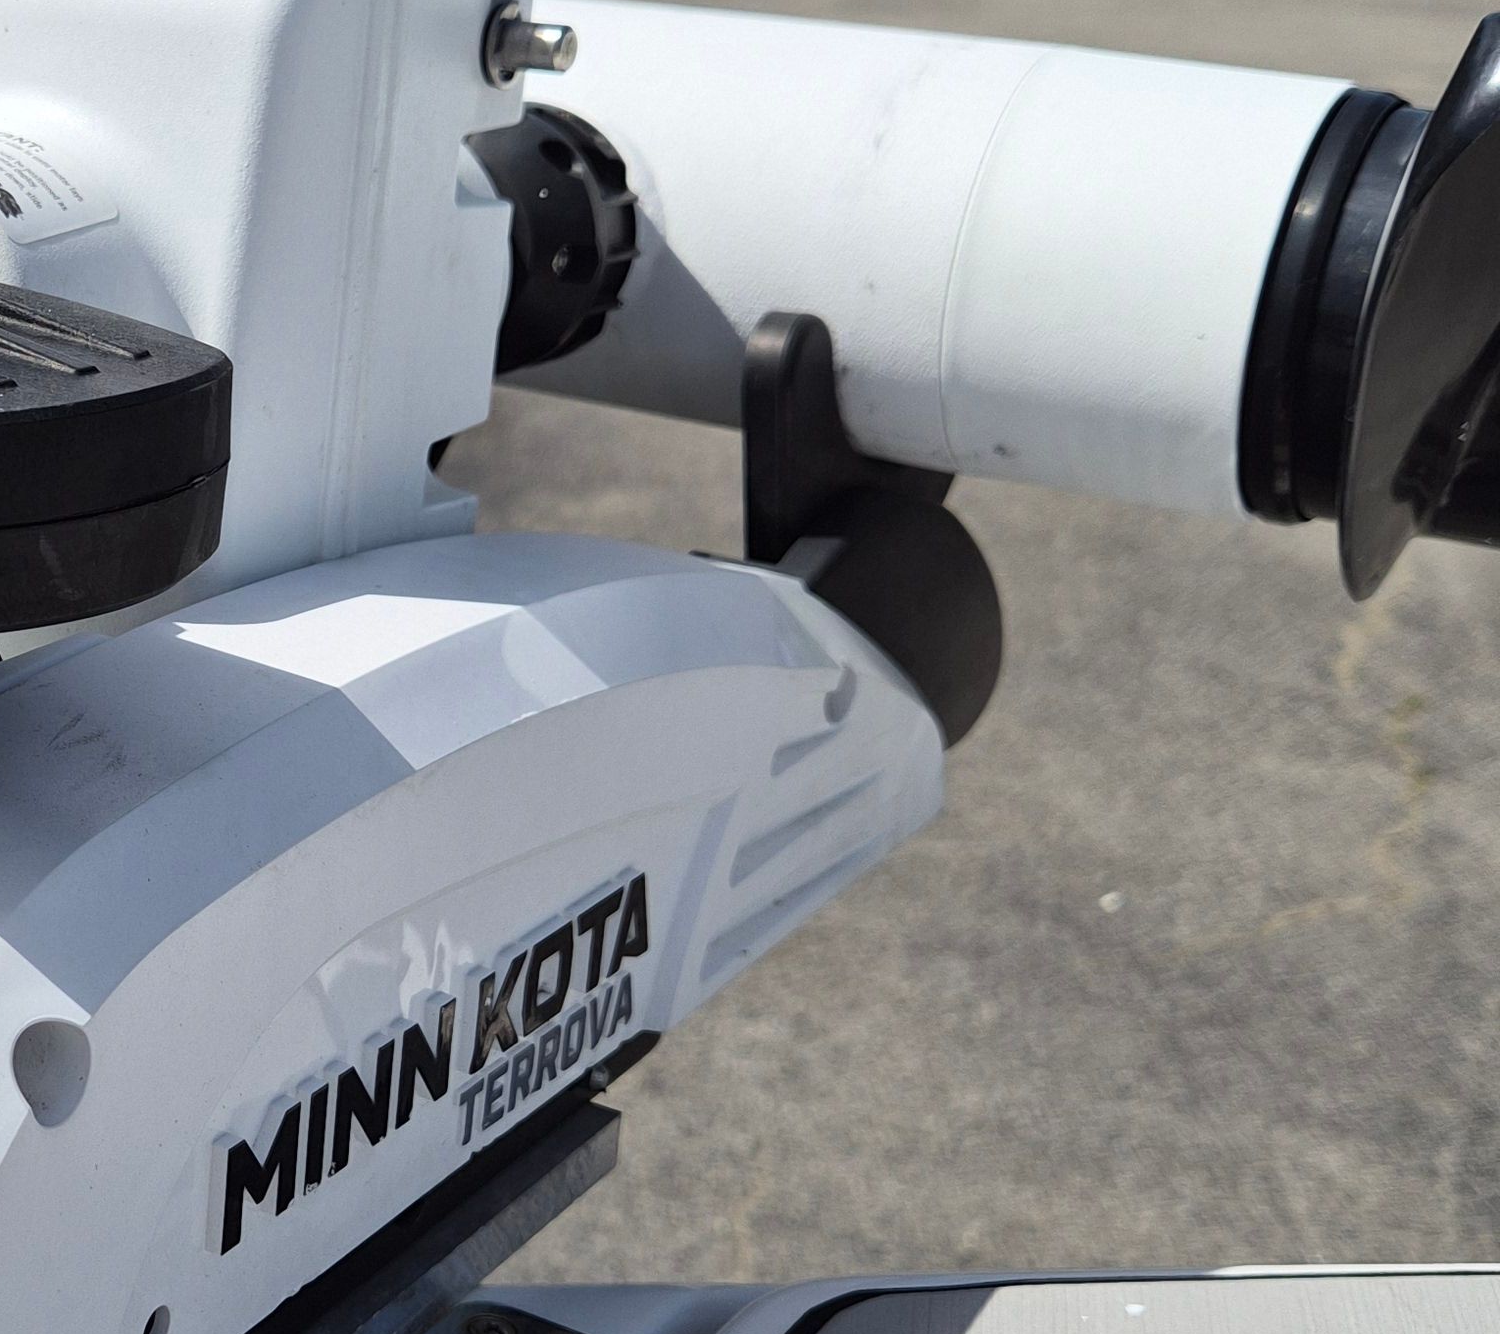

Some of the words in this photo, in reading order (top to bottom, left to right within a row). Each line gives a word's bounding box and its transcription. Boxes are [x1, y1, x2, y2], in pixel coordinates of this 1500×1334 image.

[217, 994, 457, 1257] MINN
[468, 871, 649, 1075] KOTA
[457, 973, 633, 1146] TERROVA
